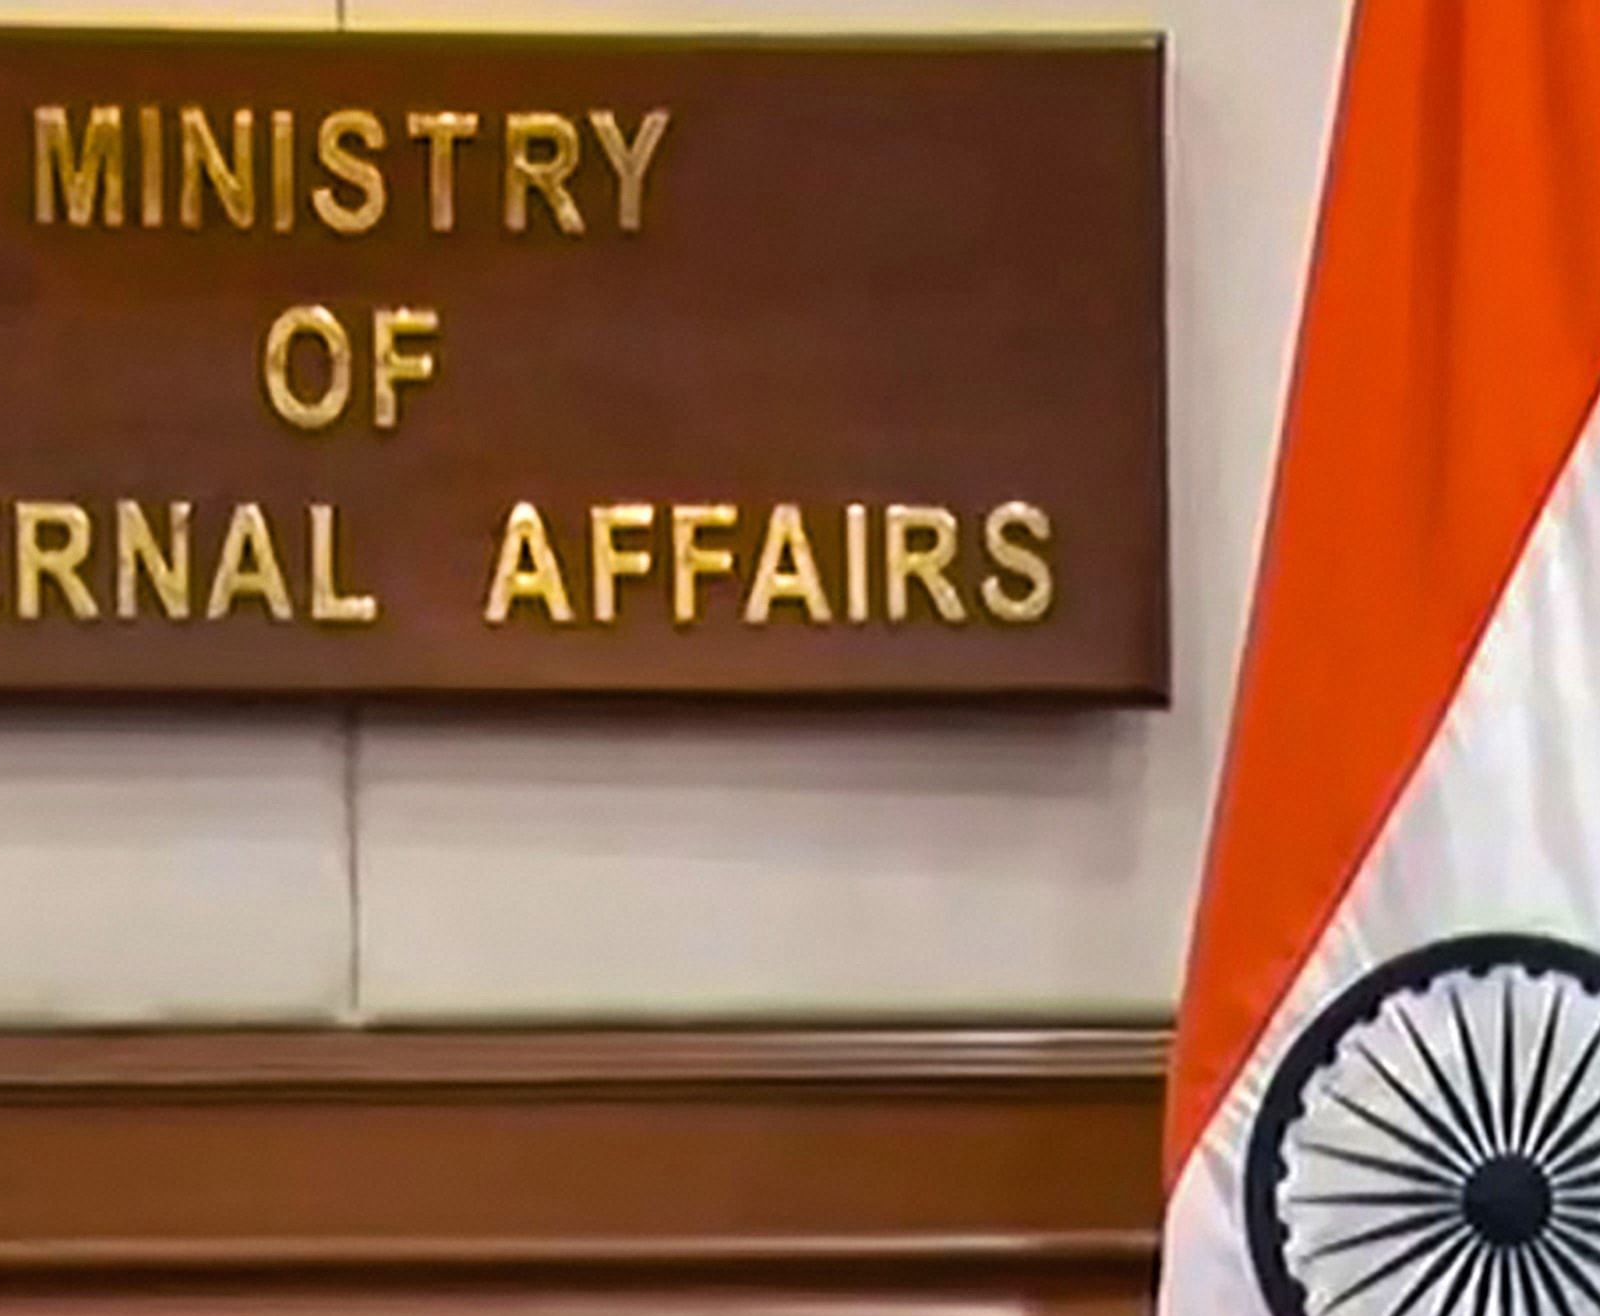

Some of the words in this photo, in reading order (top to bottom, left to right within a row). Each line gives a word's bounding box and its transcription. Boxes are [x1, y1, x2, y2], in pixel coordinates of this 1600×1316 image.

[34, 104, 669, 233] MINISTRY
[265, 302, 441, 429] OF
[483, 499, 1055, 624] AFFAIRS
